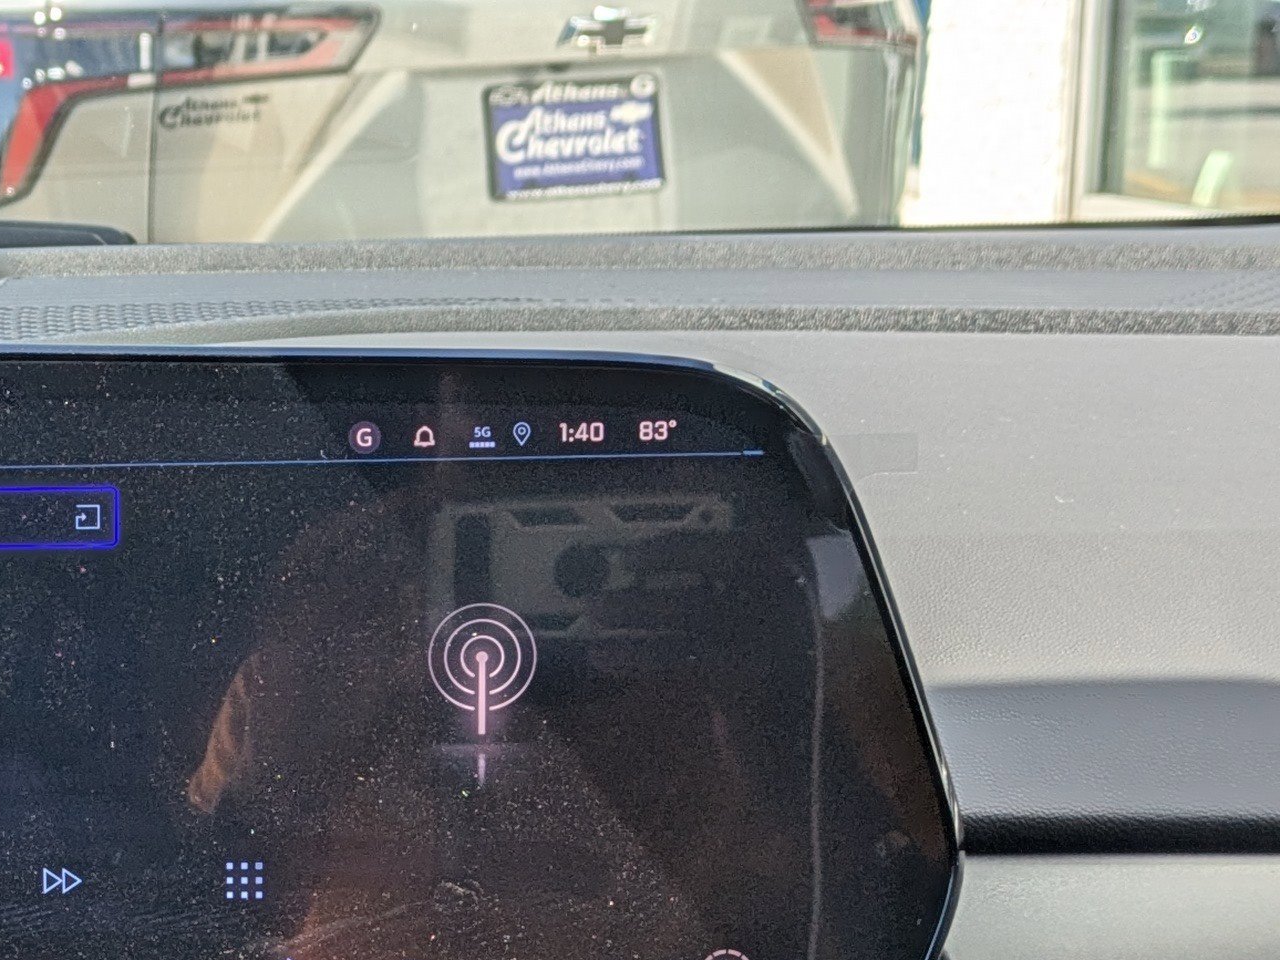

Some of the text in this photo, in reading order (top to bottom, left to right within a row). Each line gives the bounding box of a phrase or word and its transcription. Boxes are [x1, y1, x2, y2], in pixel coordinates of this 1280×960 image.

[514, 106, 608, 143] Athens
[495, 120, 644, 165] Chevrolet
[475, 426, 491, 438] 5G
[559, 422, 605, 442] 1:40
